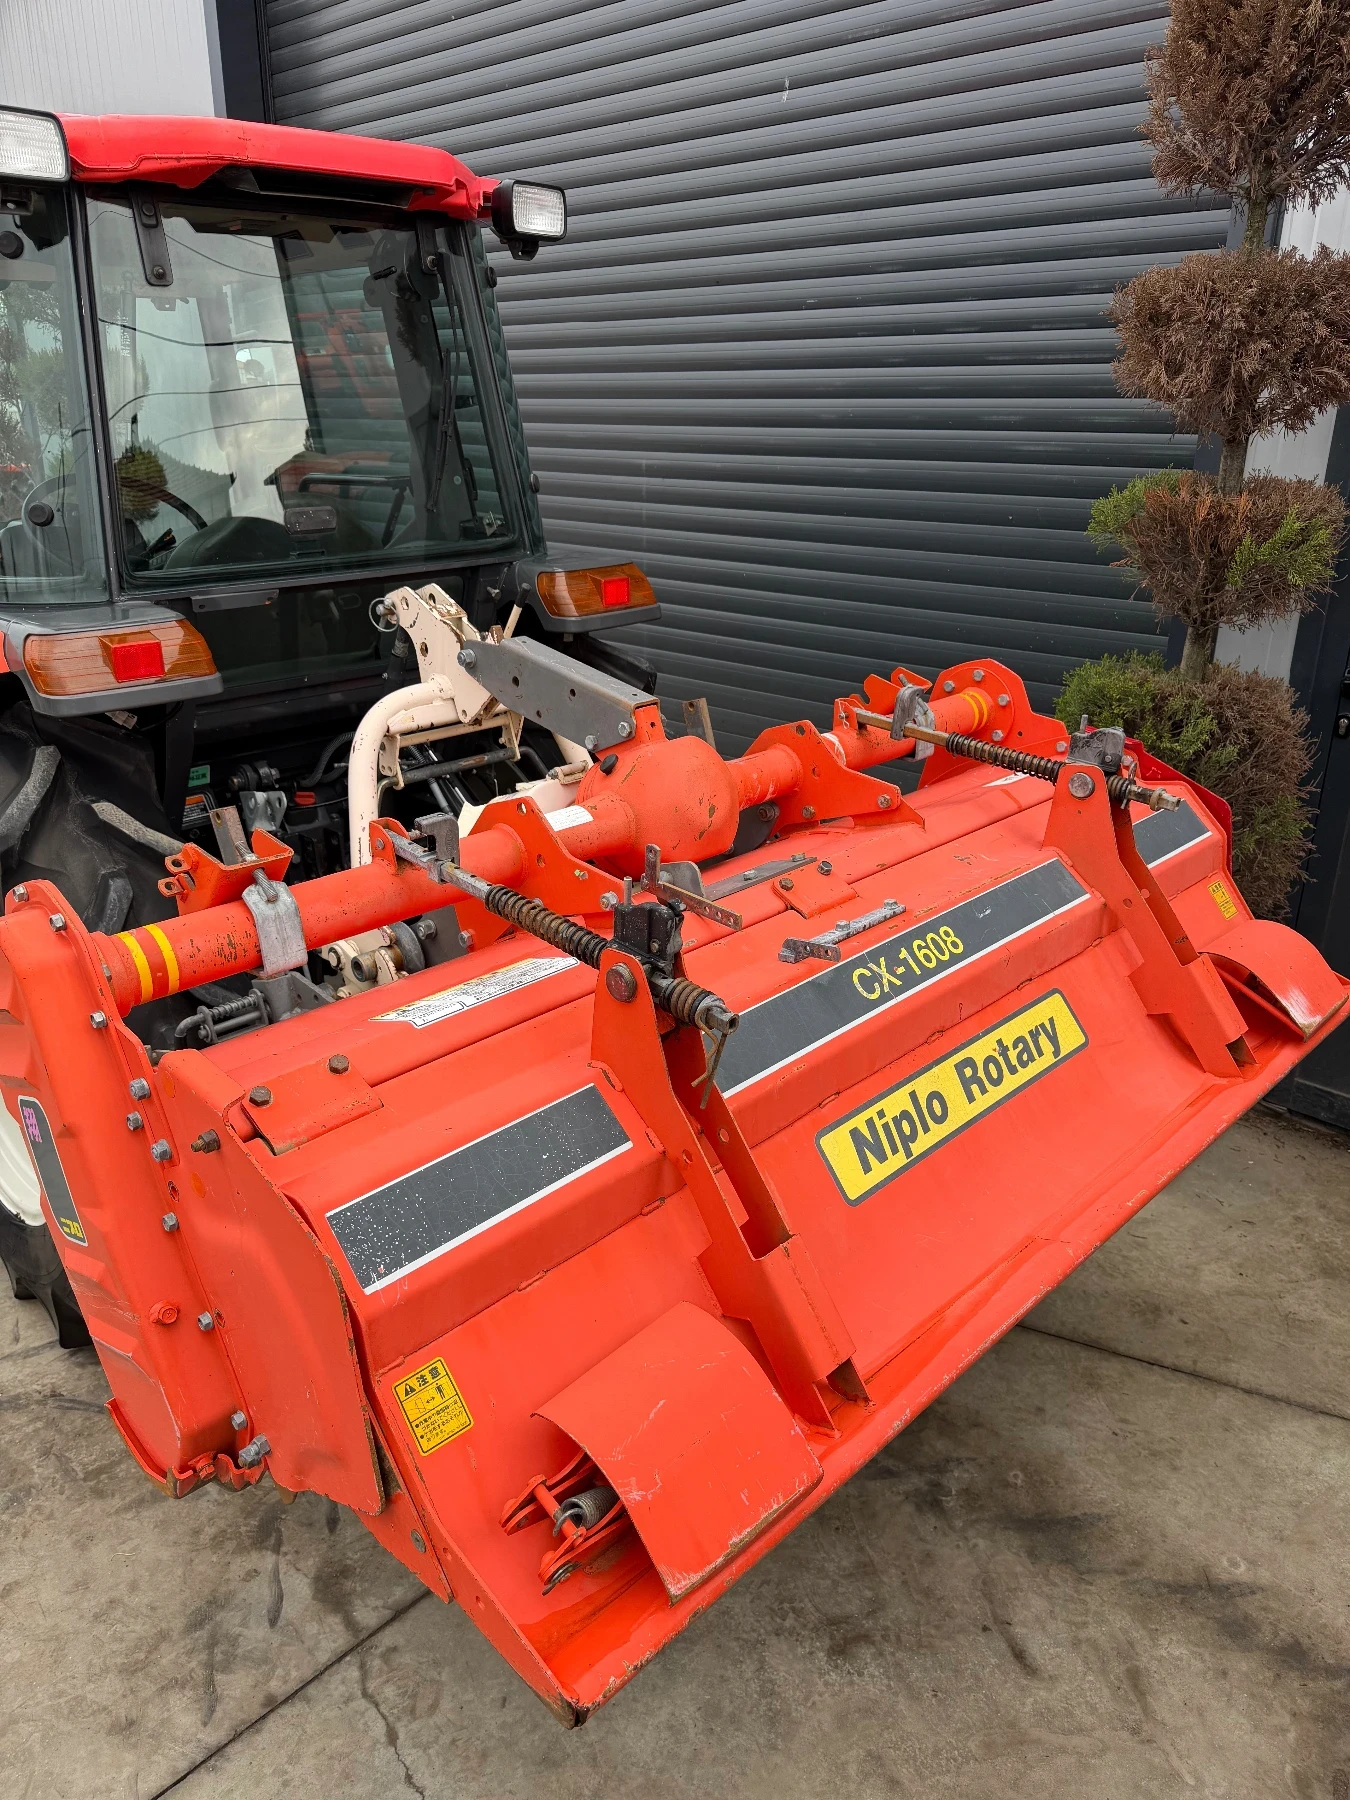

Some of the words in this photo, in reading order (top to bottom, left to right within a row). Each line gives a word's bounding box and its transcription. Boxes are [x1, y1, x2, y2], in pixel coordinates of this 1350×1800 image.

[852, 925, 964, 1000] CX-1608
[849, 1089, 949, 1175] Niplo
[954, 1015, 1061, 1104] Rotary
[415, 1366, 441, 1387] 注意
